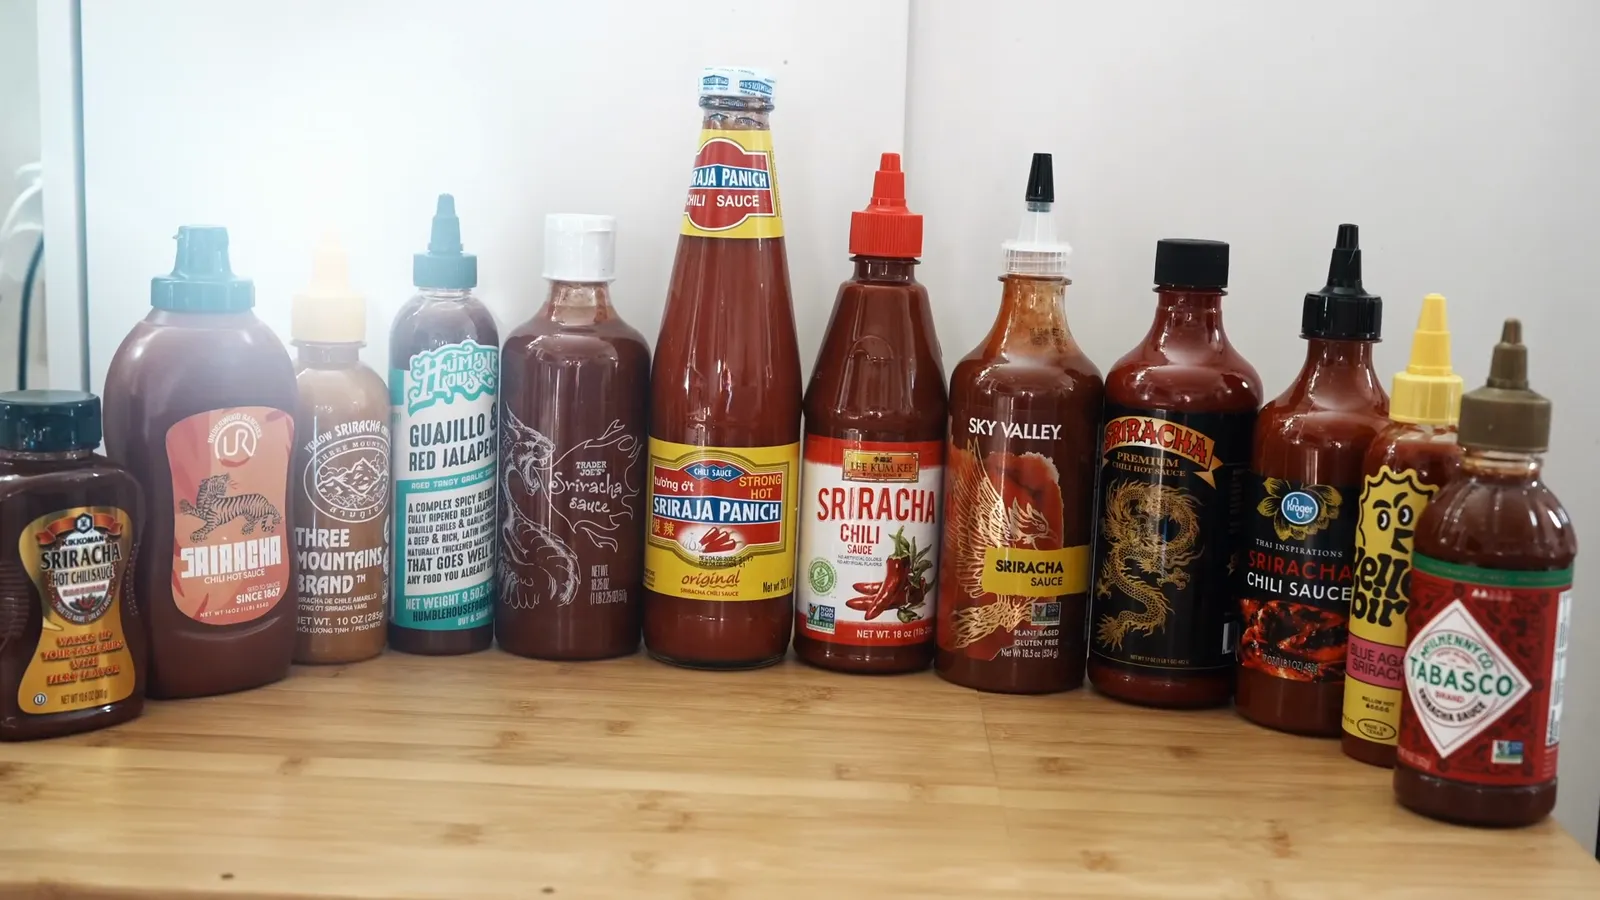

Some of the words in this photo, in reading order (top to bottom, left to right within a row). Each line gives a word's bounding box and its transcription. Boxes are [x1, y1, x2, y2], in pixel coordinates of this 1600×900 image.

[691, 167, 717, 187] RAJA
[721, 168, 767, 188] PANICH
[716, 195, 760, 208] SAUCE
[334, 419, 381, 437] SRIRACHA
[409, 413, 485, 448] GUAJILLO
[968, 417, 997, 436] SKY
[1001, 421, 1062, 440] VALLEY
[409, 450, 436, 472] RED
[576, 460, 607, 469] TRADER
[851, 461, 867, 472] LEE
[870, 463, 894, 473] KUM
[896, 463, 913, 473] KEE
[1116, 451, 1180, 468] PREMIUM
[693, 467, 709, 476] CHILI
[711, 468, 732, 477] SAUCE
[1111, 461, 1132, 472] CHILI
[1133, 465, 1153, 475] HOT
[1154, 468, 1187, 477] SAUCE
[433, 478, 458, 488] TANGY
[548, 471, 622, 499] Sriracha
[739, 475, 782, 488] STRONG
[750, 487, 773, 500] HOT
[408, 503, 413, 513] A
[416, 498, 452, 513] COMPLEX
[455, 493, 477, 508] SPICY
[653, 496, 714, 522] SRIRAJA
[719, 500, 779, 522] PANICH
[817, 486, 936, 524] SRIRACHA
[1286, 496, 1315, 519] Kroger
[408, 513, 427, 524] FULLY
[429, 510, 458, 523] RIPENED
[460, 505, 473, 517] RED
[435, 521, 456, 533] CHILES
[458, 518, 465, 529] &
[840, 523, 880, 544] CHILI
[62, 534, 104, 547] KIKKOMAN
[295, 526, 350, 549] THREE
[414, 535, 430, 546] DEEP
[432, 533, 439, 544] &
[180, 535, 282, 578] SRIRACHA
[407, 546, 440, 557] NATURALLY
[442, 541, 473, 554] THICKENED
[847, 544, 873, 555] SAUCE
[1255, 538, 1273, 549] THAI
[1275, 543, 1343, 558] INSPIRATIONS
[40, 543, 121, 571] SRIRACHA
[297, 546, 383, 572] MOUNTAINS
[407, 558, 432, 572] THAT
[437, 553, 464, 570] GOES
[467, 545, 489, 564] WELL
[407, 575, 421, 585] ANY
[423, 573, 441, 584] FOOD
[444, 570, 459, 582] YOU
[461, 562, 487, 579] ALREADY
[995, 559, 1064, 575] SRIRACHA
[1248, 549, 1353, 583] SRIRACHA
[51, 571, 69, 587] HOT
[70, 568, 91, 585] CHILI
[91, 564, 115, 581] SAUCE
[204, 574, 225, 585] CHILI
[226, 572, 242, 582] HOT
[243, 568, 265, 580] SAUCE
[681, 569, 741, 588] original
[1030, 577, 1063, 587] SAUCE
[680, 587, 706, 596] SRIRACHA
[706, 588, 721, 597] CHILI
[762, 580, 773, 593] Net
[1247, 572, 1283, 594] CHILI
[1289, 582, 1352, 601] SAUCE
[236, 590, 263, 604] SINCE
[263, 587, 281, 599] 1867
[334, 596, 352, 604] CHILE
[405, 598, 421, 610] NET
[423, 593, 460, 609] WEIGHT
[1352, 575, 1410, 627] bir
[313, 617, 332, 626] WT.
[336, 617, 349, 626] 10
[350, 615, 364, 625] OZ
[56, 632, 96, 648] WAKES
[856, 630, 874, 639] NET
[876, 630, 890, 639] WT.
[893, 630, 902, 639] 18
[903, 630, 912, 638] oz
[1014, 639, 1043, 647] GLUTEN
[41, 648, 72, 662] YOUR
[1001, 647, 1012, 657] Net
[1012, 648, 1022, 658] Wt
[1022, 648, 1034, 659] 18.5
[1350, 643, 1375, 660] BLUE
[1352, 659, 1402, 682] SRIRAC
[1409, 655, 1514, 697] TABASCO
[1435, 690, 1465, 703] BRAND
